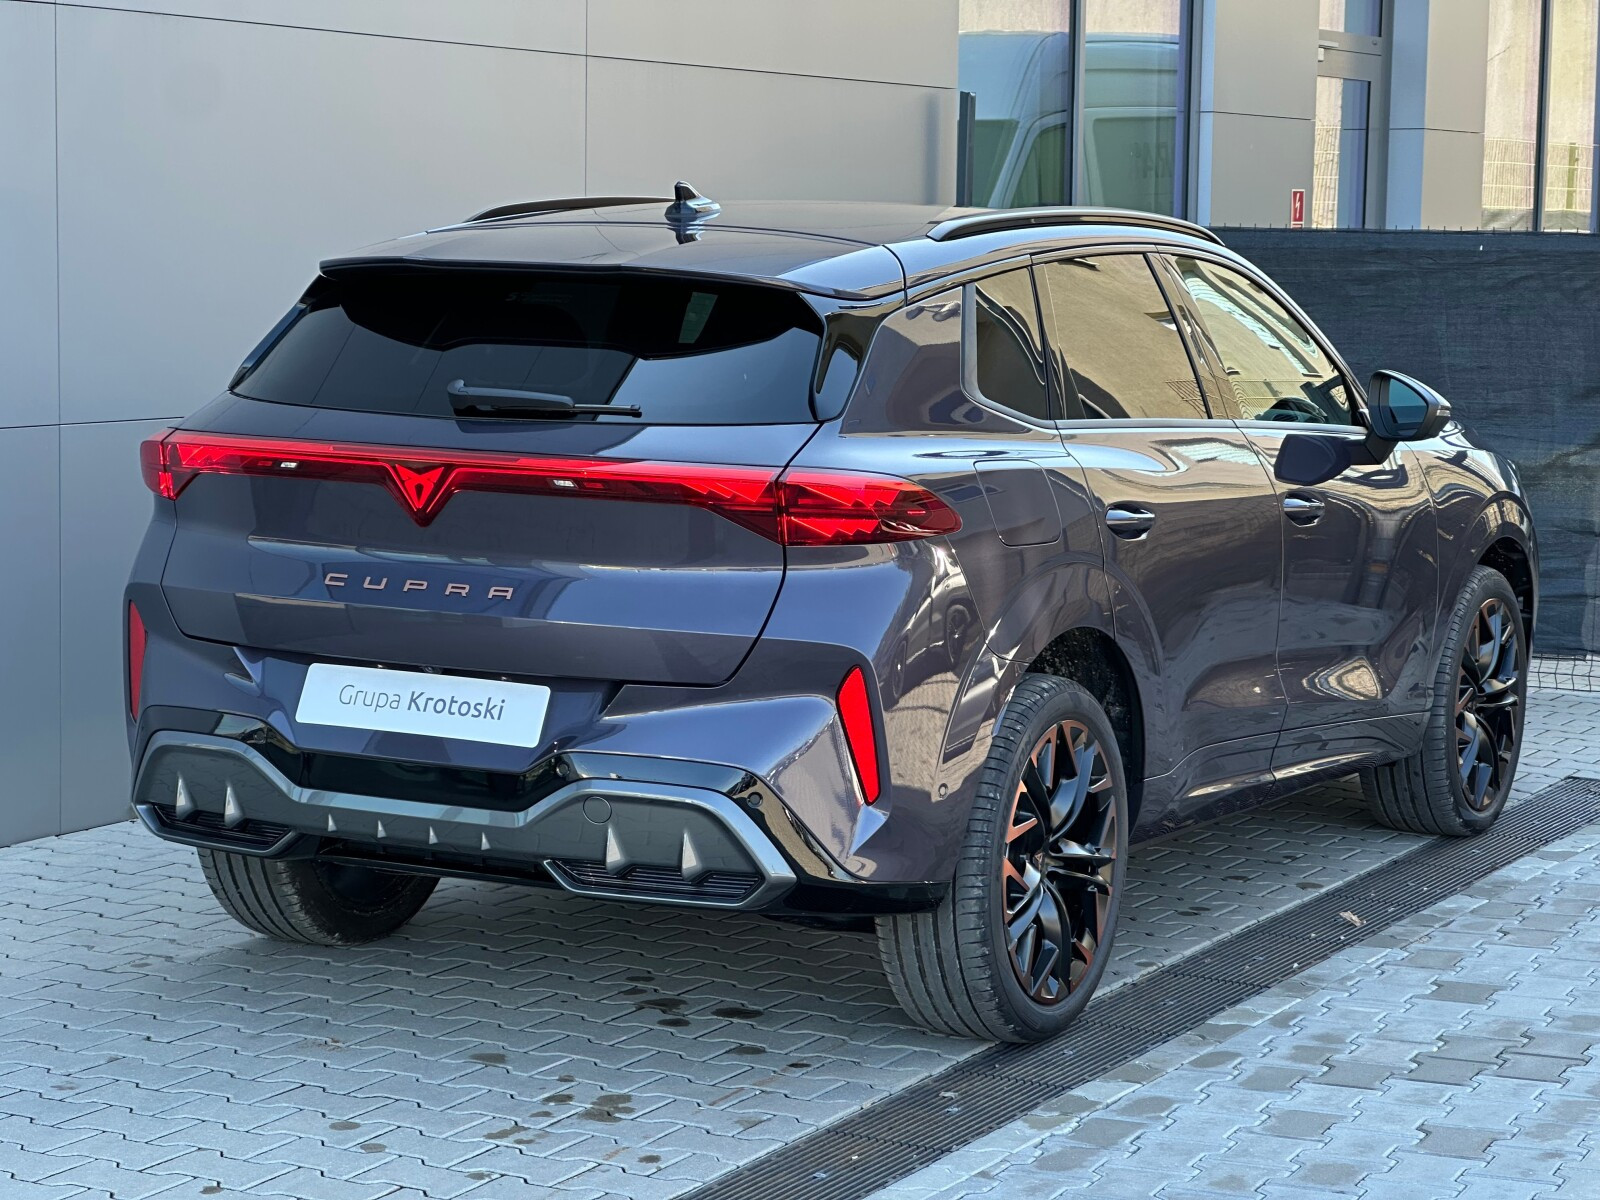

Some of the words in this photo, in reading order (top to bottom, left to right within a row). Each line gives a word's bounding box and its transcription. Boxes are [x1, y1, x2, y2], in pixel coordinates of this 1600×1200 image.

[324, 572, 514, 600] CUPRA
[339, 684, 401, 713] Grupa
[407, 690, 506, 721] Krotoski
